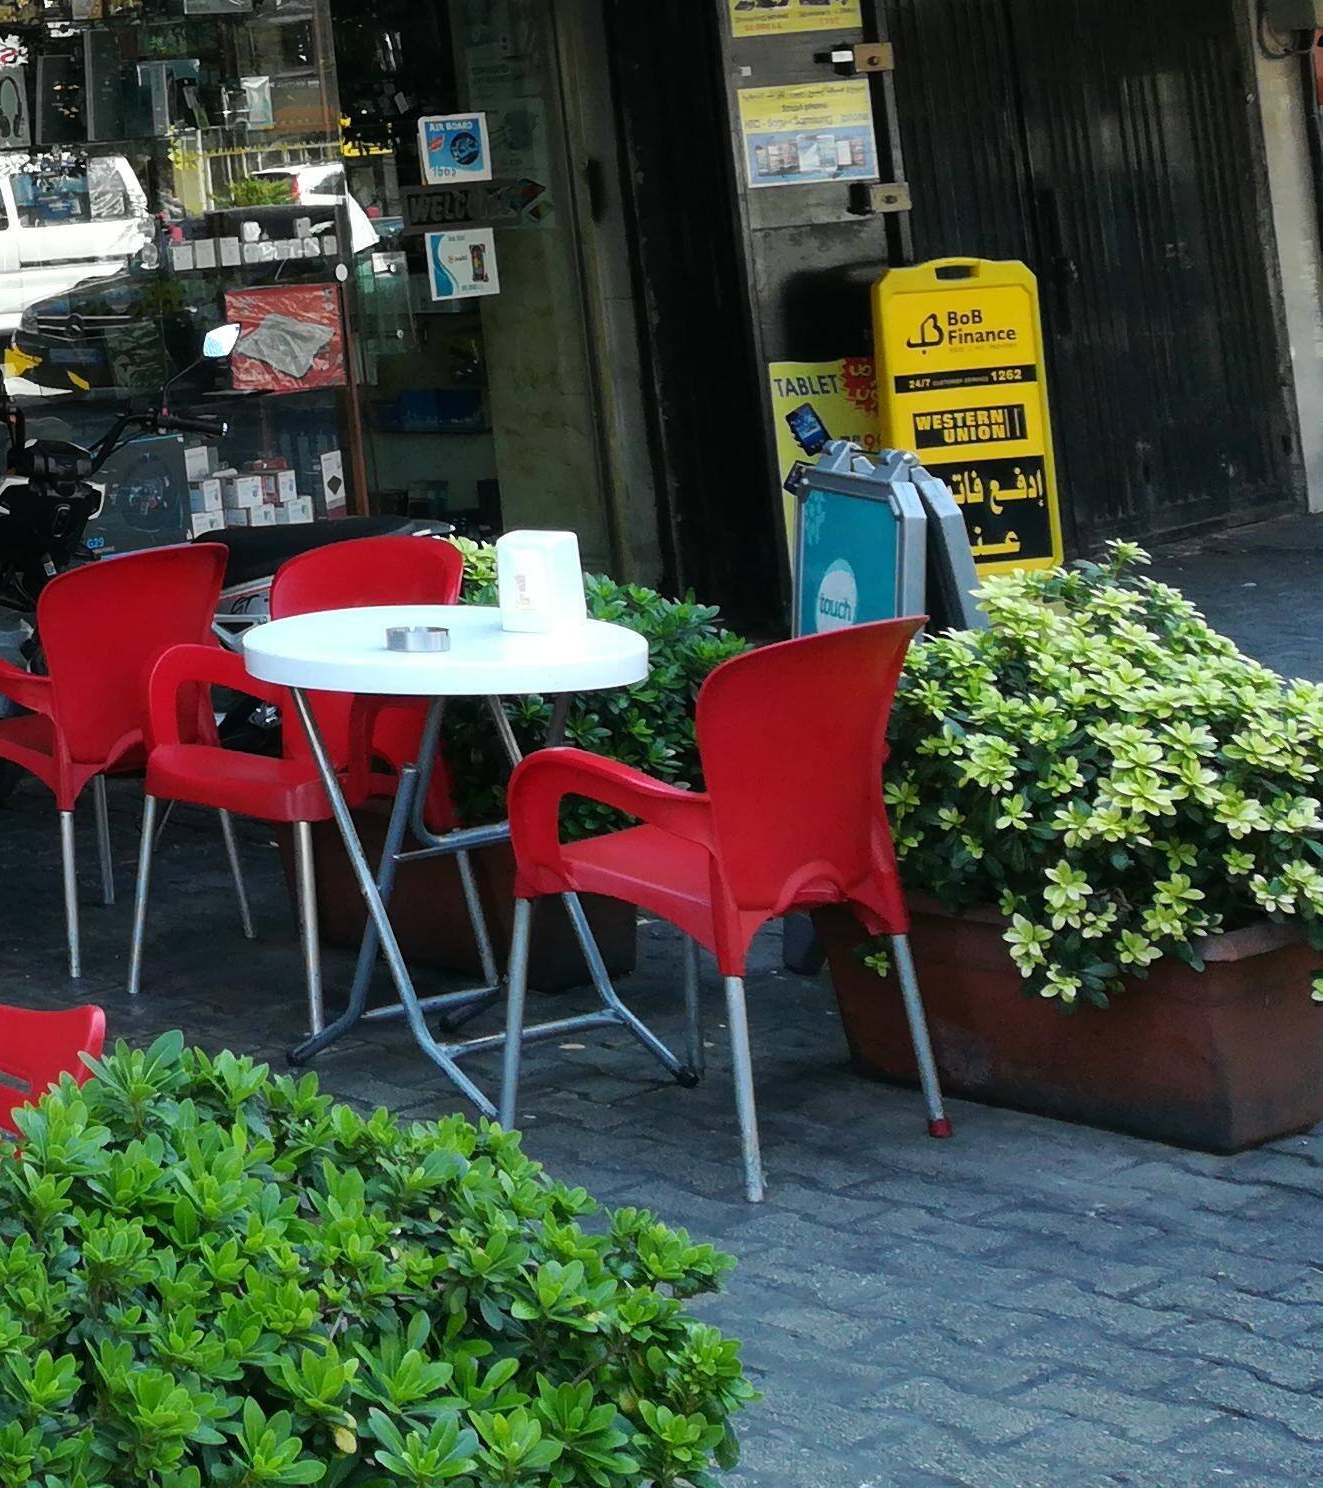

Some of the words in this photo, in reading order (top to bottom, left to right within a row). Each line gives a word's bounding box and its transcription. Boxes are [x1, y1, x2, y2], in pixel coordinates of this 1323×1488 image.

[947, 309, 983, 326] BoB
[947, 327, 1017, 346] Finance
[774, 373, 839, 399] TABLET
[908, 378, 931, 390] 24/7
[990, 368, 1023, 382] 1262
[915, 408, 1005, 431] WESTERN
[943, 423, 1006, 444] UNION
[990, 466, 1044, 515] إدفع
[819, 595, 853, 618] touch
